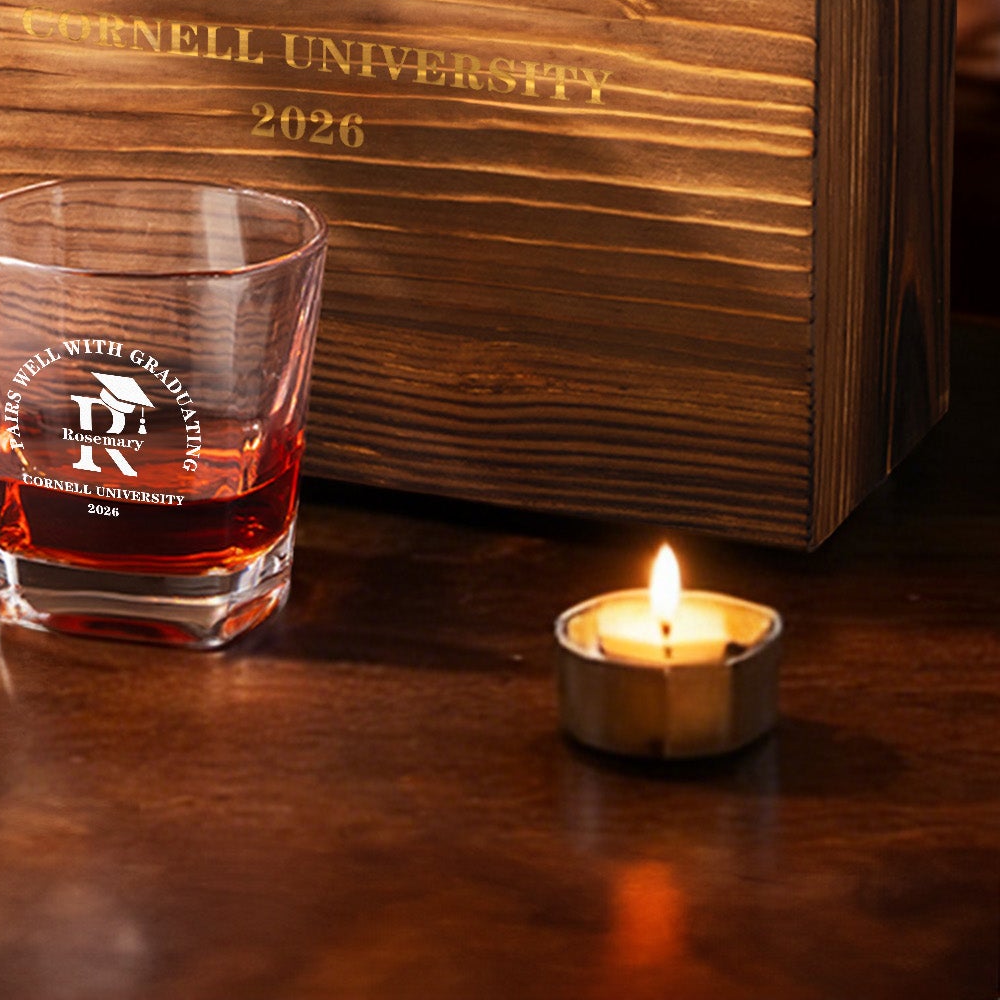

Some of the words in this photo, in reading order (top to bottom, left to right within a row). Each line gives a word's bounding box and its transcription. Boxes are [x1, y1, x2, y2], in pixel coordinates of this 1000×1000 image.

[21, 5, 264, 64] CORNELL
[281, 33, 614, 105] UNIVERSITY
[250, 102, 366, 148] 2026
[12, 347, 62, 387] WELL
[62, 339, 124, 358] WITH
[4, 389, 25, 450] PAIRS
[129, 349, 202, 472] GRADUATING
[61, 427, 145, 451] Rosemary
[23, 474, 92, 495] CORNELL
[96, 486, 185, 506] UNIVERSITY
[87, 503, 120, 517] 2026
